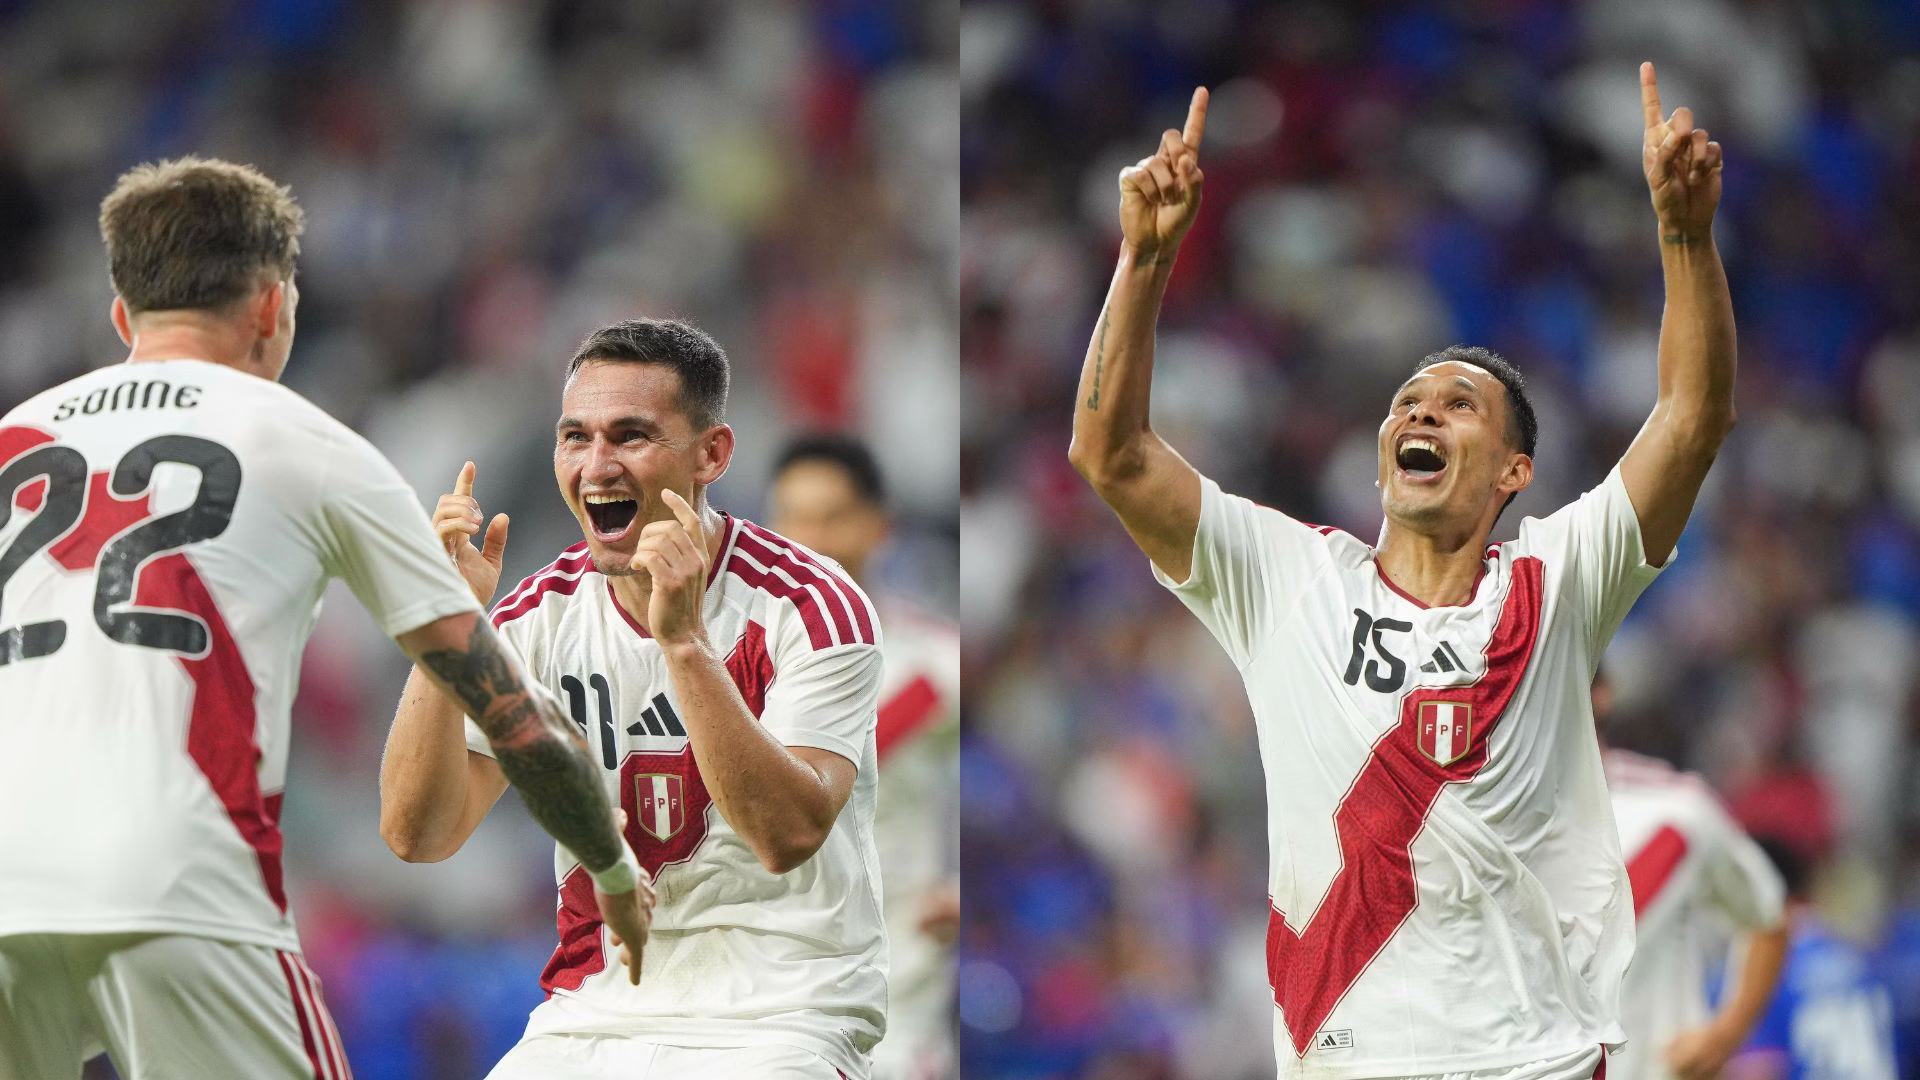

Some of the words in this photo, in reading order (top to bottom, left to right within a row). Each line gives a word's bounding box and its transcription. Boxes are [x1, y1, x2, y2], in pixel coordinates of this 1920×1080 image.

[0, 434, 242, 666] 22
[1343, 608, 1413, 694] 15
[560, 673, 618, 771] 11
